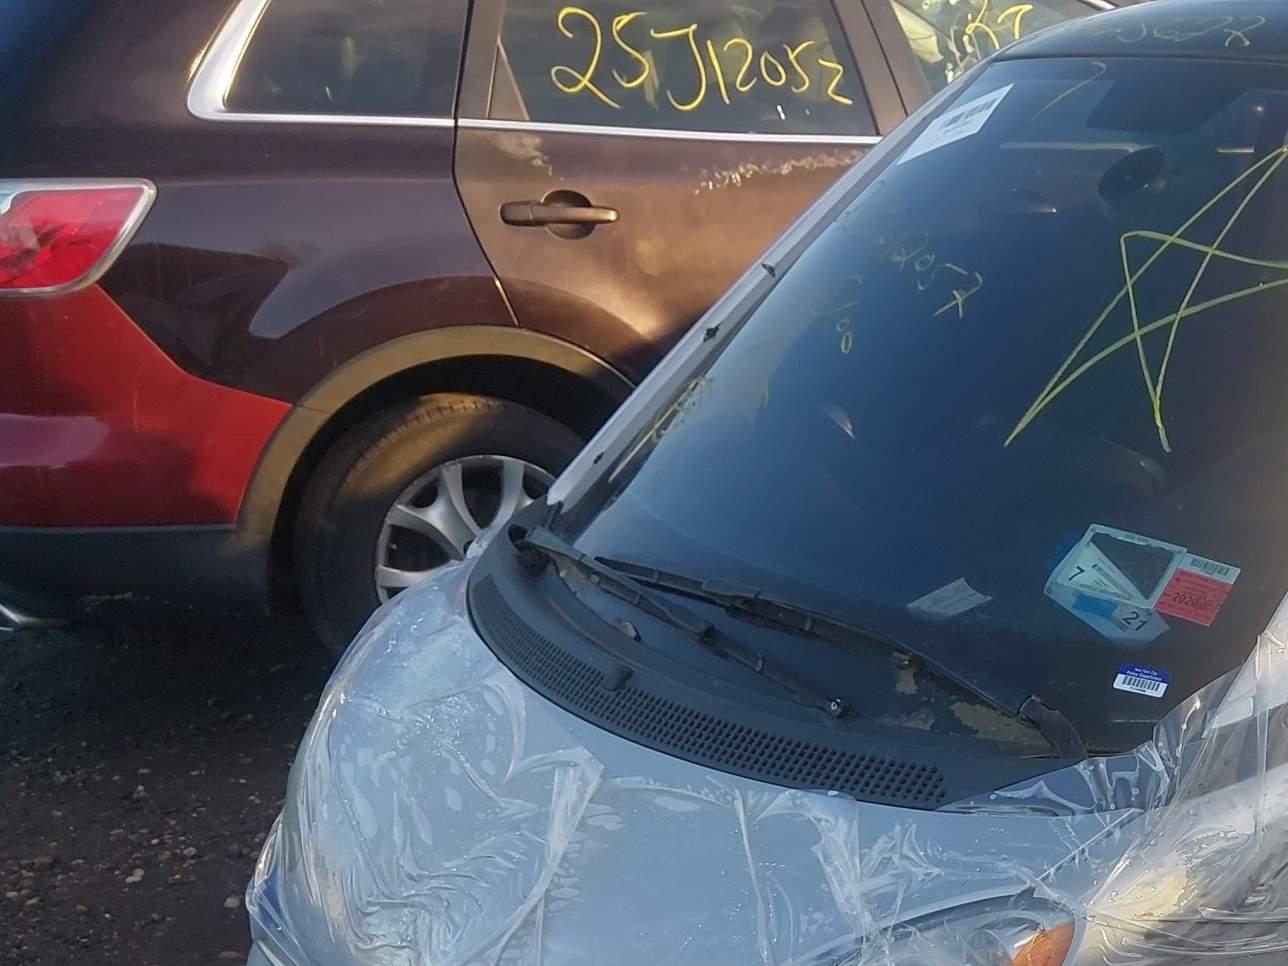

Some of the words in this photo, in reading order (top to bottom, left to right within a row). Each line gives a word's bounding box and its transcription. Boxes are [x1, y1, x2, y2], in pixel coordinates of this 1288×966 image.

[1068, 565, 1085, 582] 7
[1172, 591, 1199, 608] 2020
[1122, 610, 1148, 631] 21
